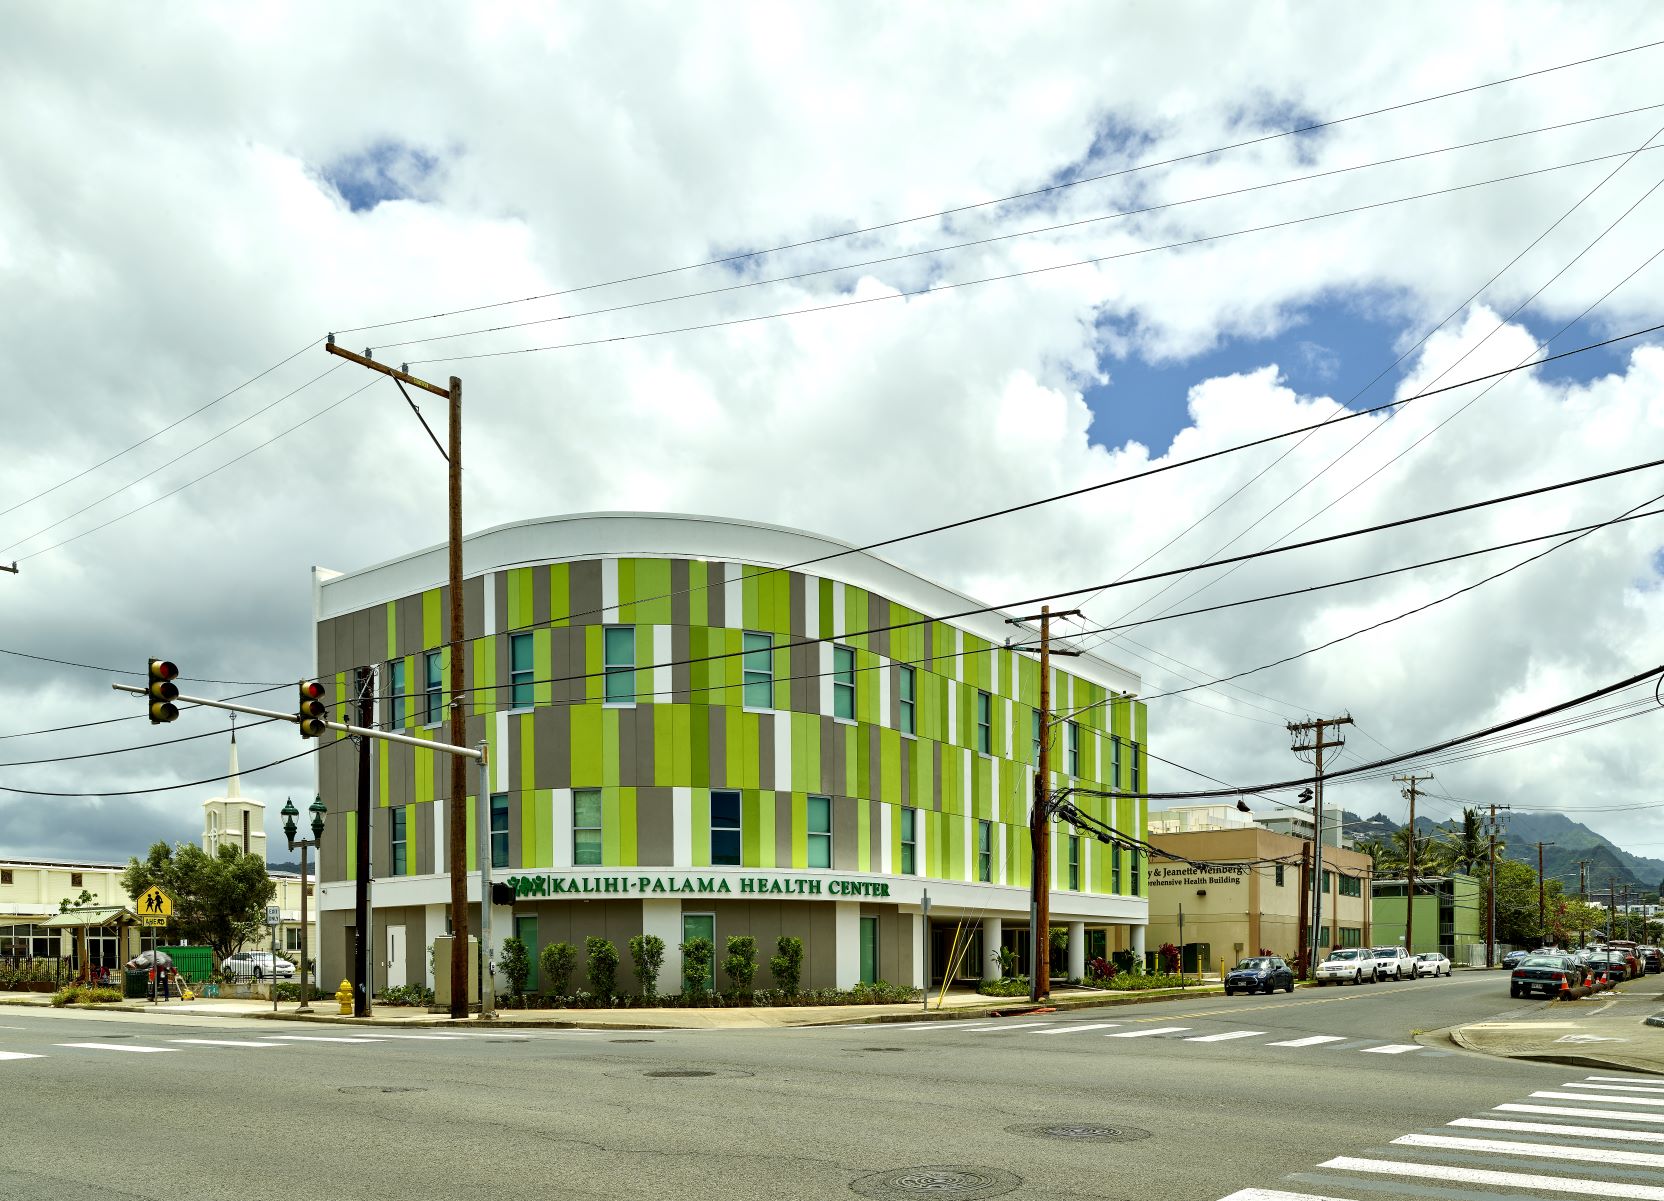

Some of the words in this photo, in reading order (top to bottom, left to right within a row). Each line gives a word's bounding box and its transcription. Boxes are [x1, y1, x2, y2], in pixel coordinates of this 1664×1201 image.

[1153, 868, 1162, 877] &
[1163, 867, 1198, 878] Jeanette
[1200, 866, 1243, 875] Weinberg
[1183, 877, 1207, 885] Health
[1209, 876, 1240, 885] Building
[552, 877, 732, 893] KALIHI-PALAMA
[740, 878, 822, 894] HEALTH
[828, 880, 891, 897] CENTER
